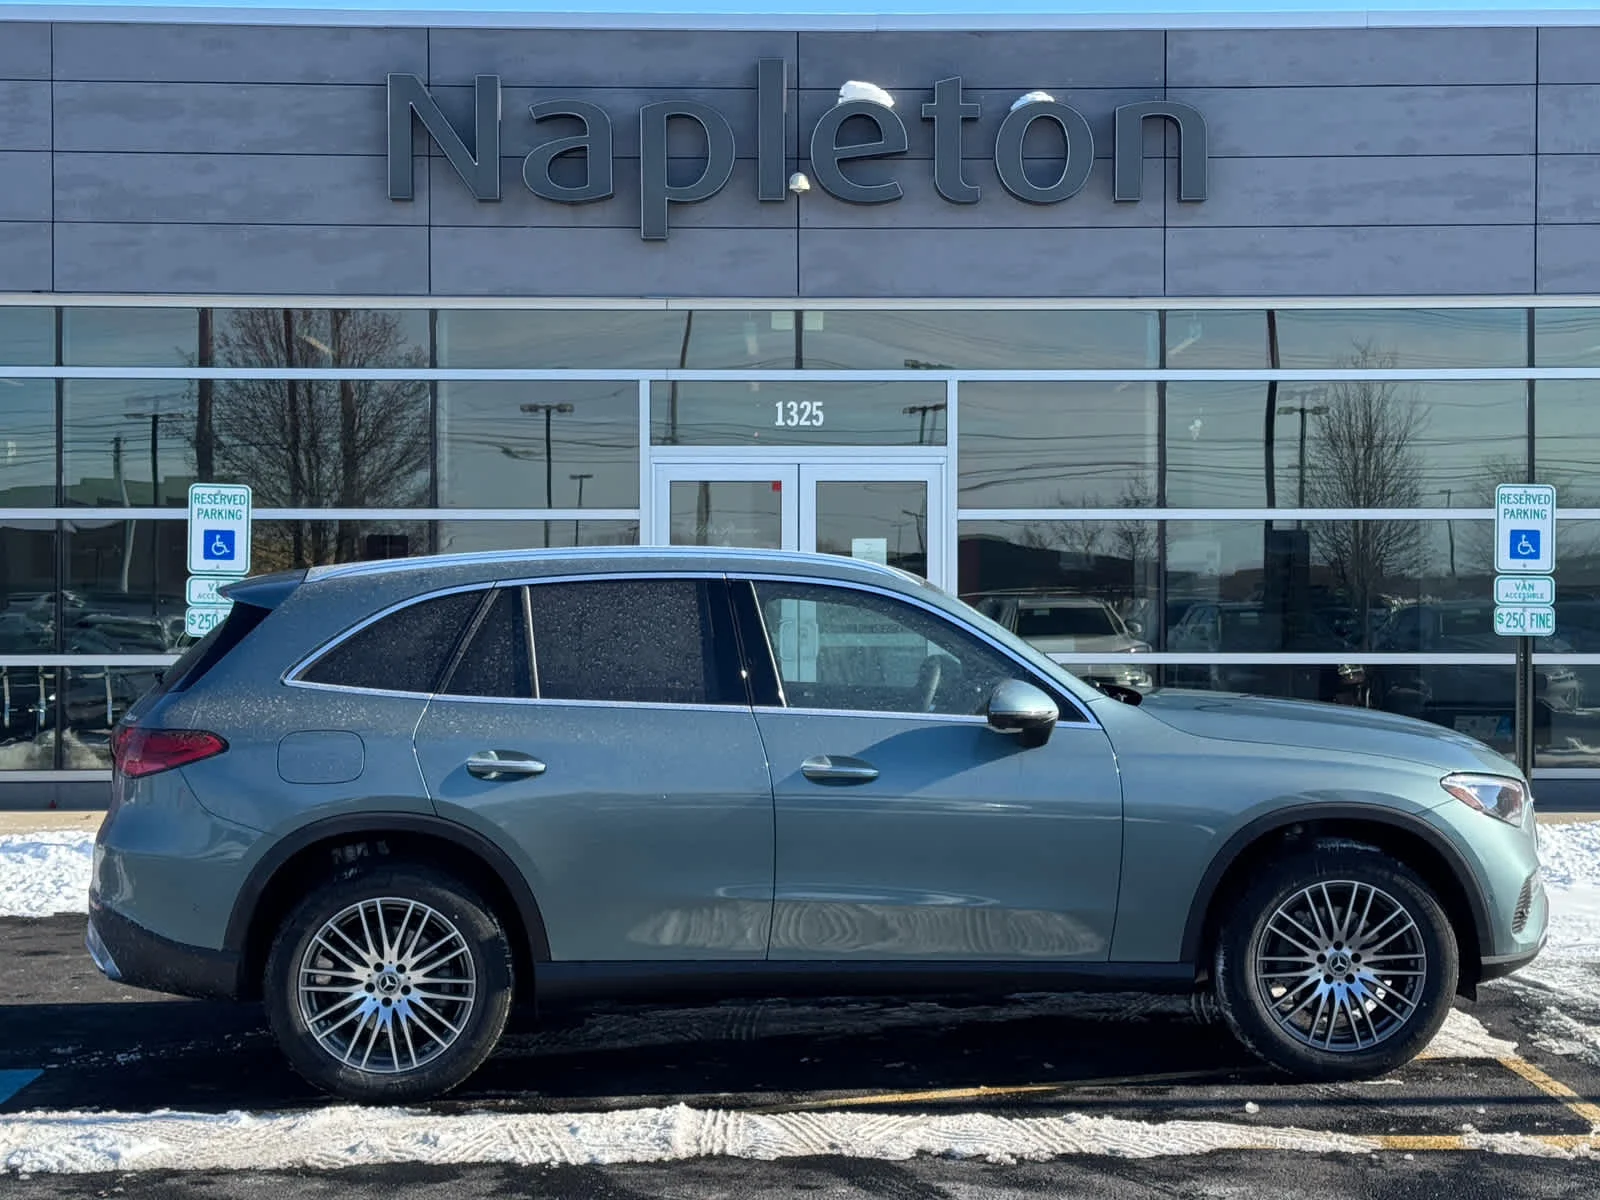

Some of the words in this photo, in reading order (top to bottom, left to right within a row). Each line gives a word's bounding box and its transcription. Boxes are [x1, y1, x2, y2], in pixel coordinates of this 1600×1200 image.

[386, 57, 1208, 240] Napleton
[775, 401, 824, 426] 1325
[194, 493, 246, 505] RESERVED
[1500, 493, 1551, 505] RESERVED
[197, 508, 242, 520] PARKING
[1503, 508, 1547, 520] PARKING
[1514, 583, 1535, 591] VAN
[1530, 613, 1552, 629] FINE
